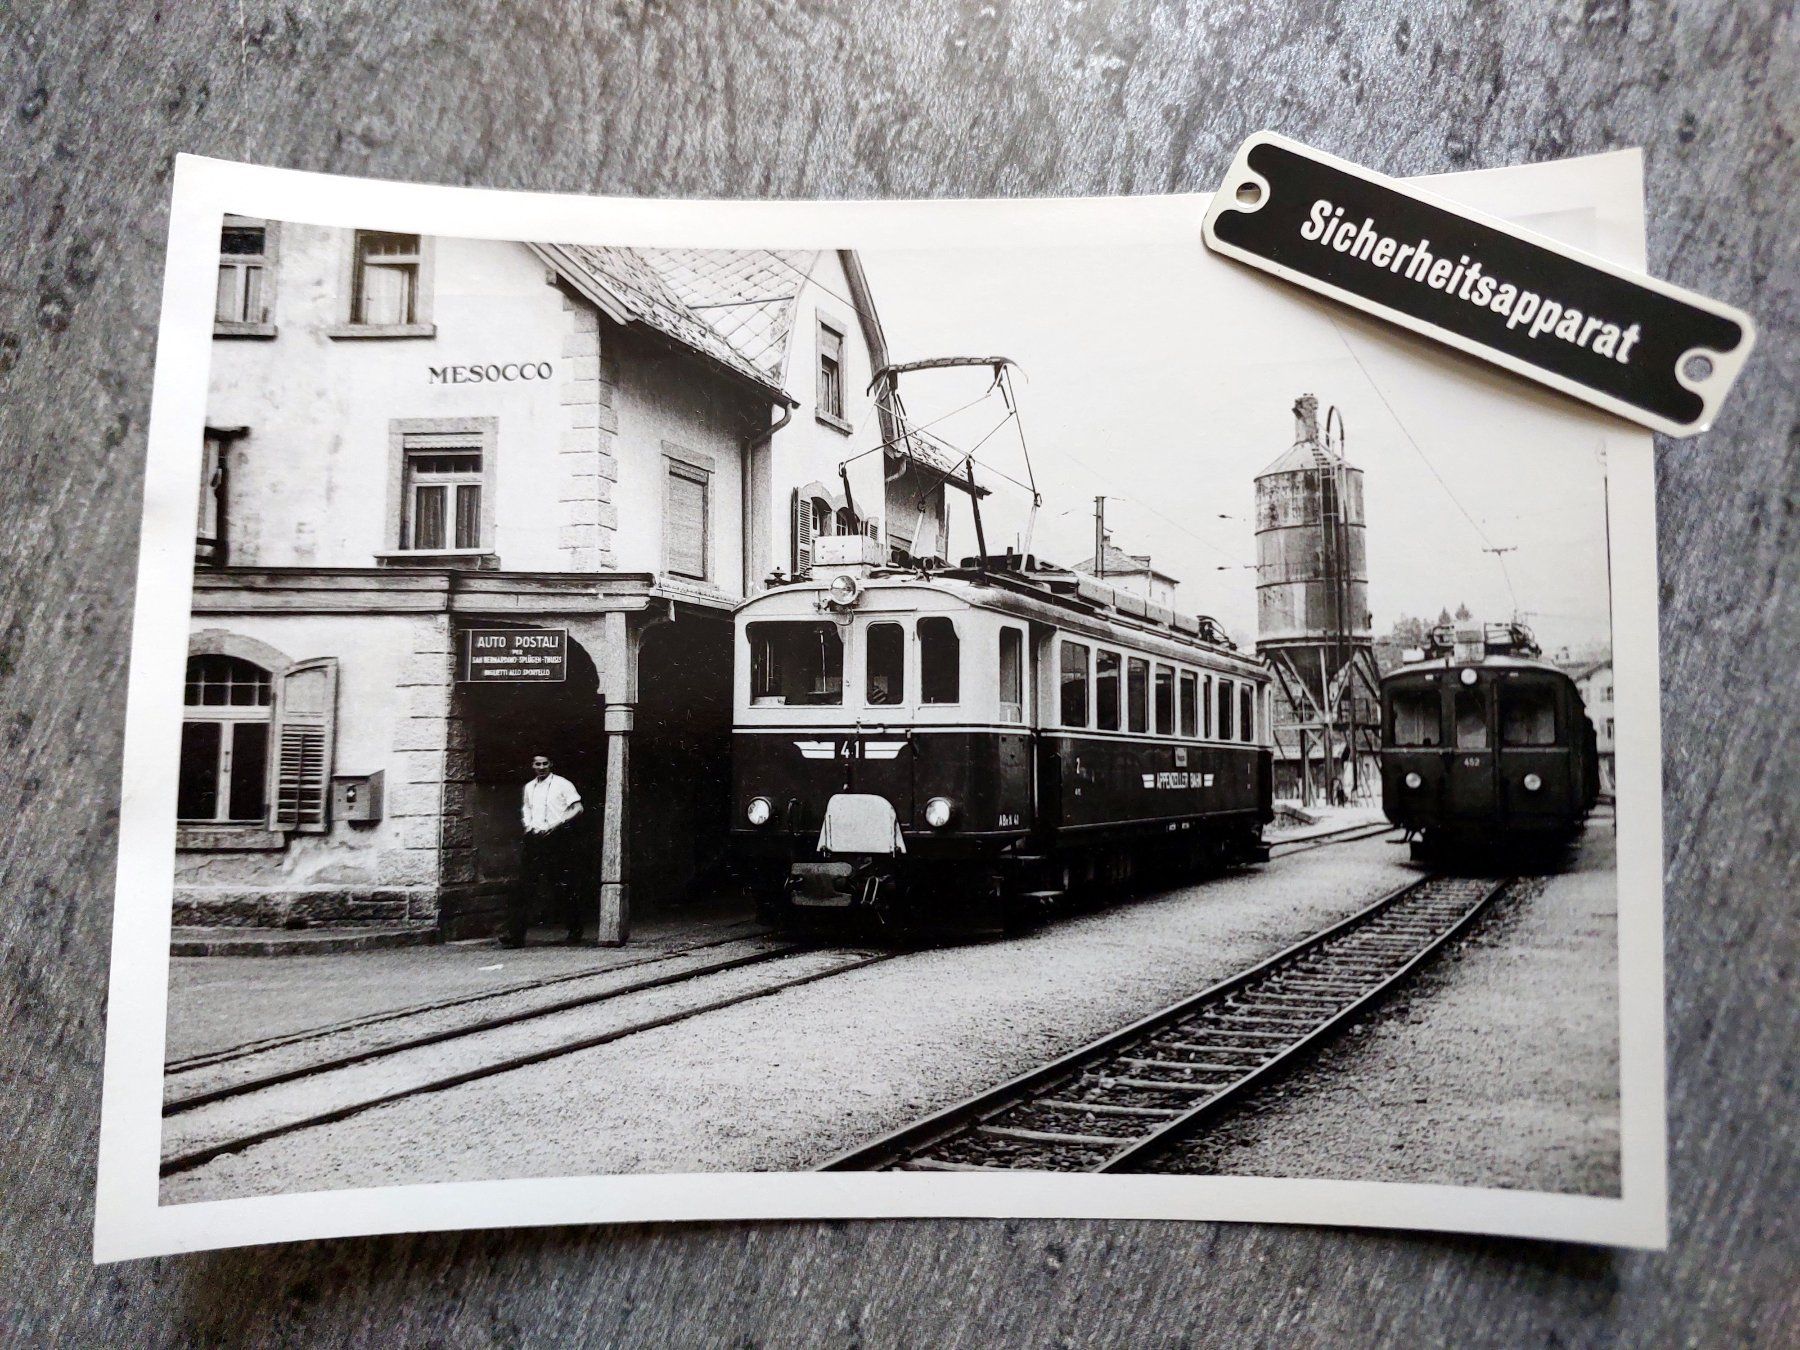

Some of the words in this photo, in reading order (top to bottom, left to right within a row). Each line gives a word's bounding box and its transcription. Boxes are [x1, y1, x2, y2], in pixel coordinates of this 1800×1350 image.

[1300, 199, 1641, 364] Sicherheitsapparat
[428, 362, 553, 385] MESOCCO
[477, 636, 507, 648] AUTO
[515, 635, 559, 648] POSTALI
[840, 740, 860, 759] 41
